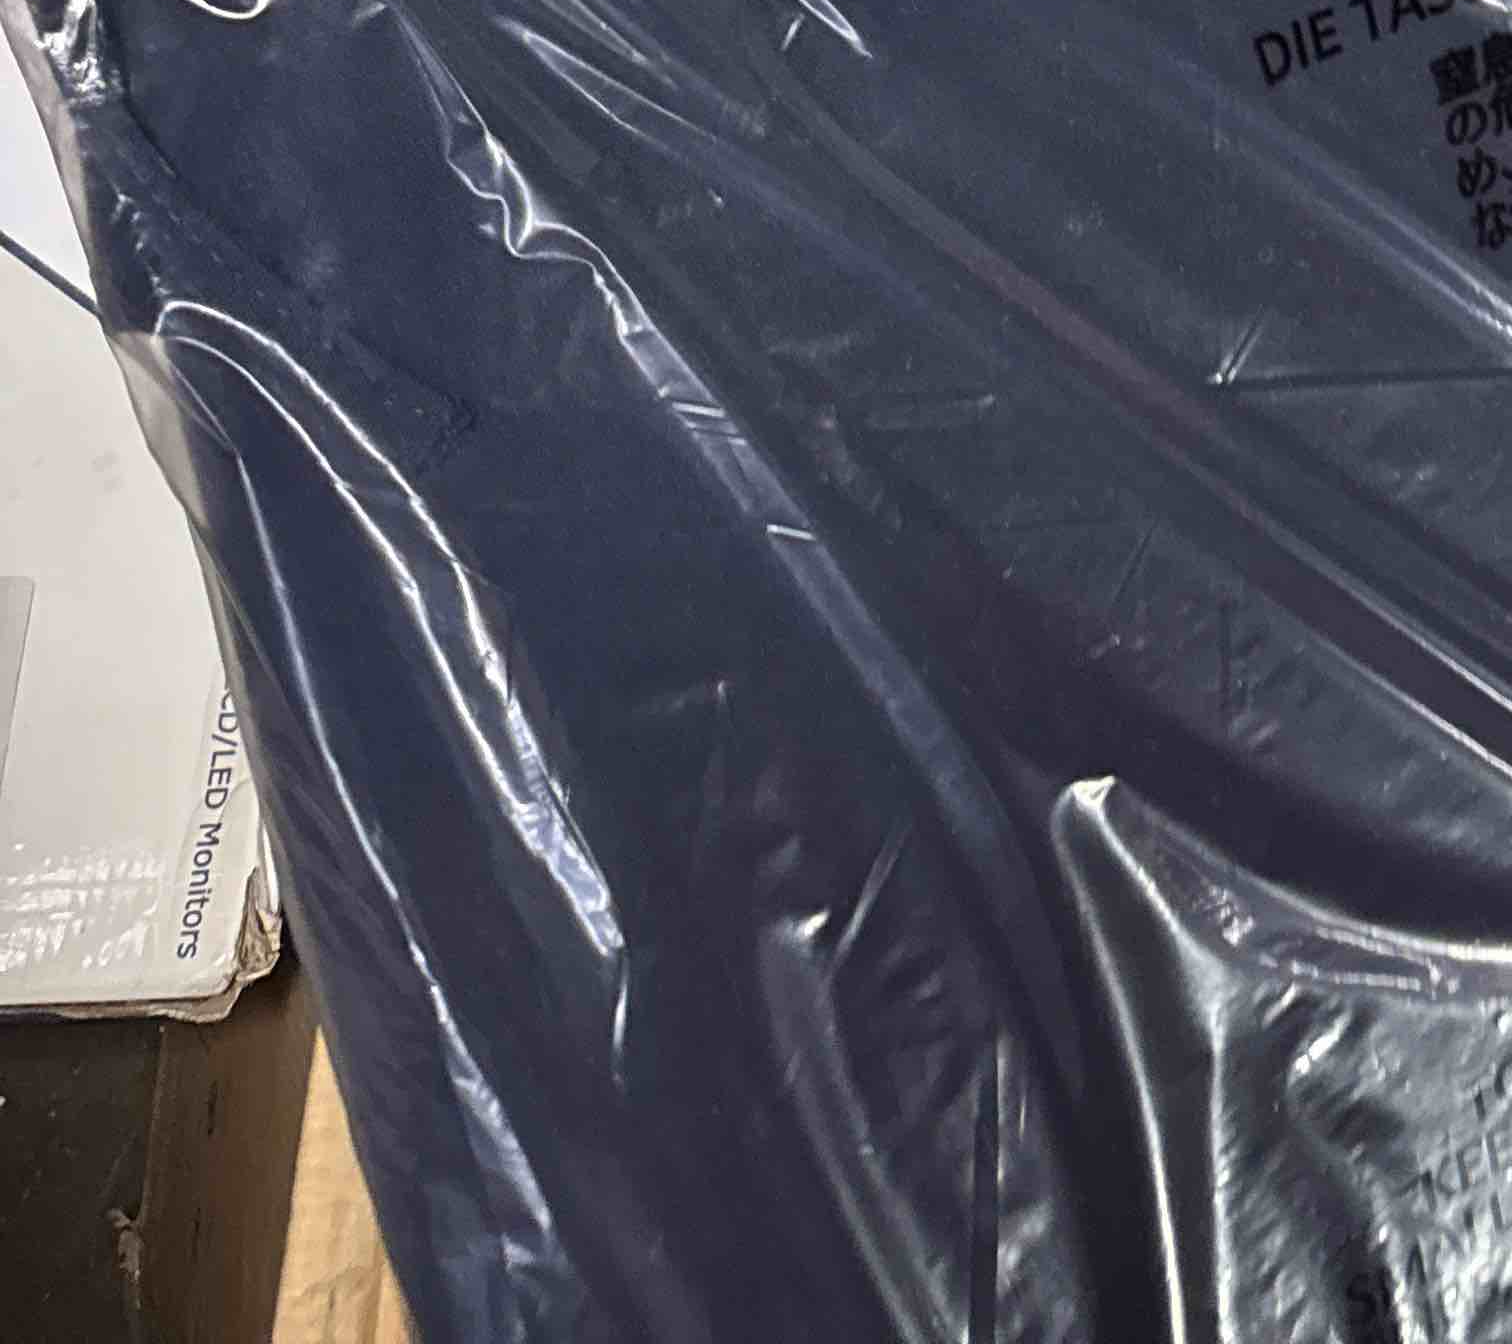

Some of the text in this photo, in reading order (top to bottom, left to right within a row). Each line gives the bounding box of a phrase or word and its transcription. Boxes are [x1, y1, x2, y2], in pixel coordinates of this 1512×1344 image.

[1253, 10, 1344, 87] DIE
[176, 688, 240, 961] D/LED Monitors
